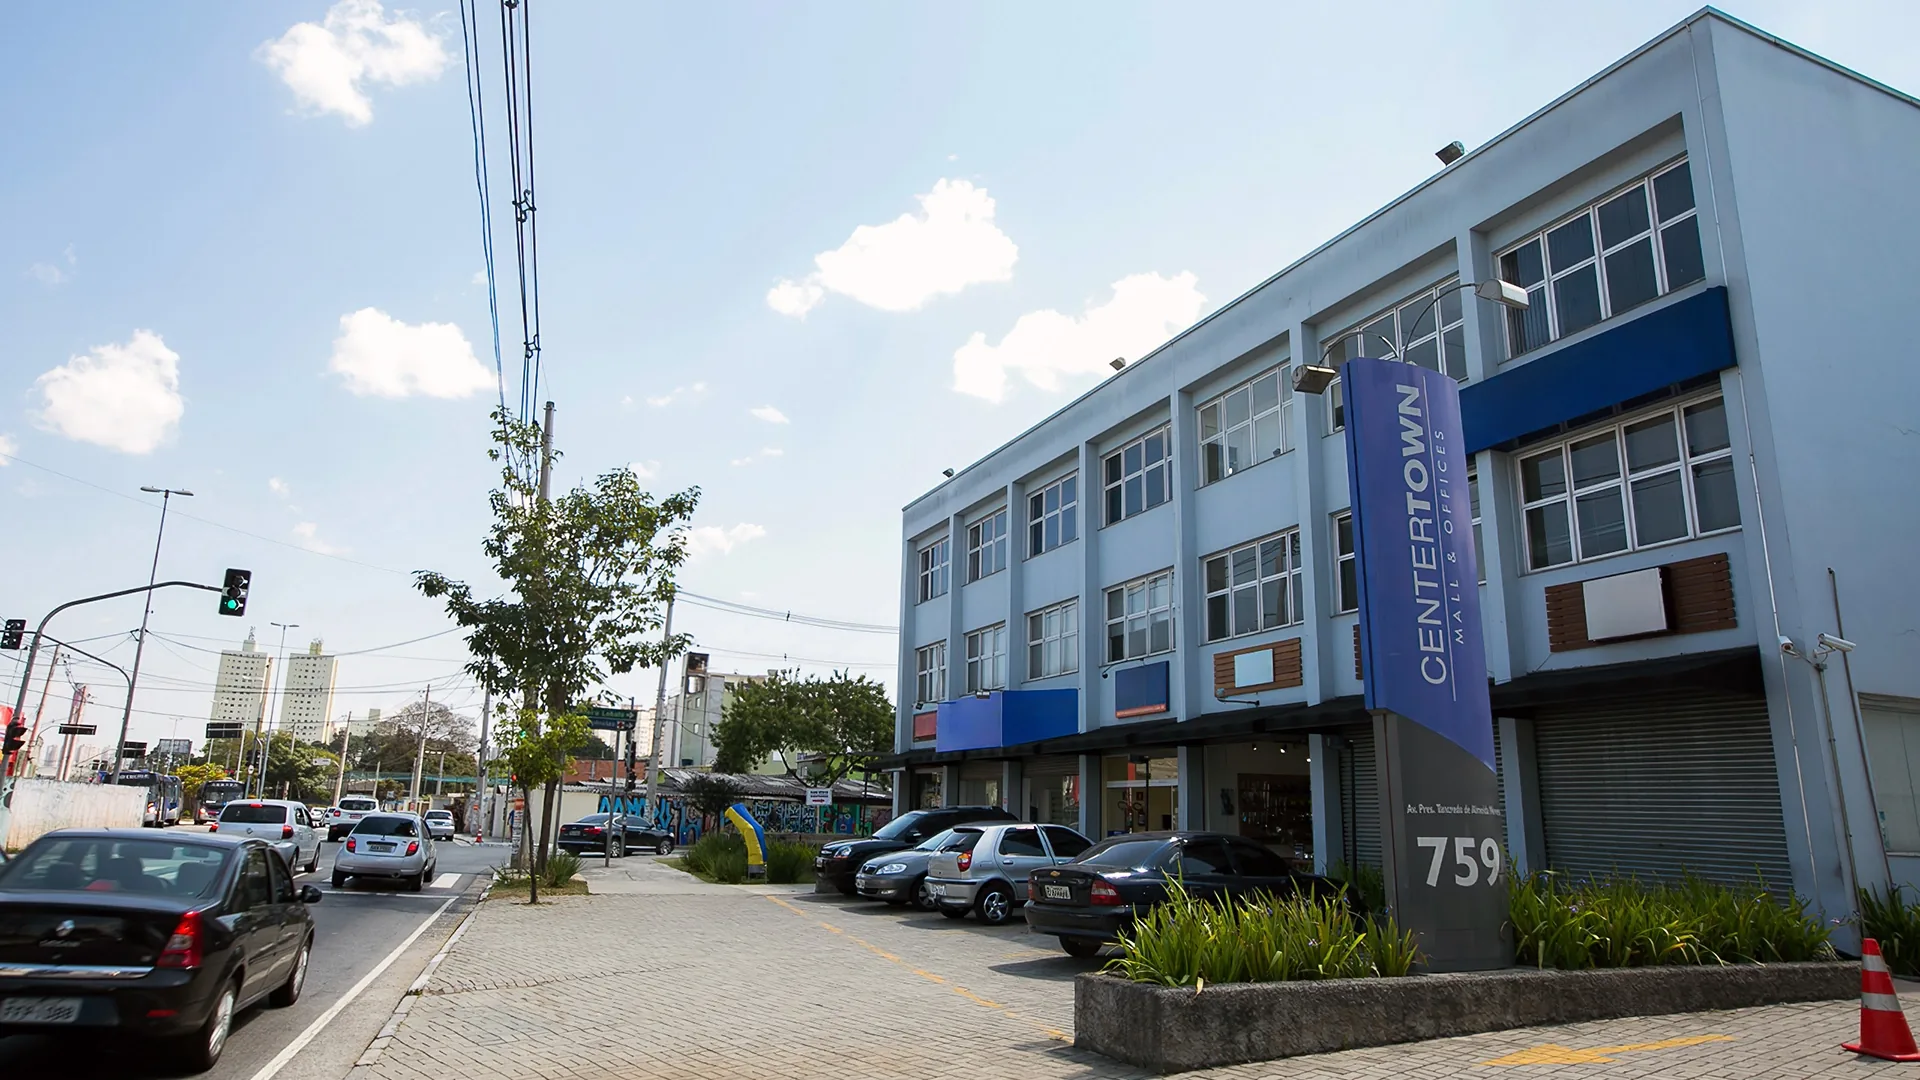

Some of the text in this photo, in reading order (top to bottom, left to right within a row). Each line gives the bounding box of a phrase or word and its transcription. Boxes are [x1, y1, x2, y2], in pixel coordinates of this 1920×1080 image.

[1396, 384, 1447, 685] CENTERTOWN
[1434, 430, 1464, 645] MALL & OFFICES
[1416, 836, 1500, 887] 759
[1418, 803, 1436, 814] Pres.
